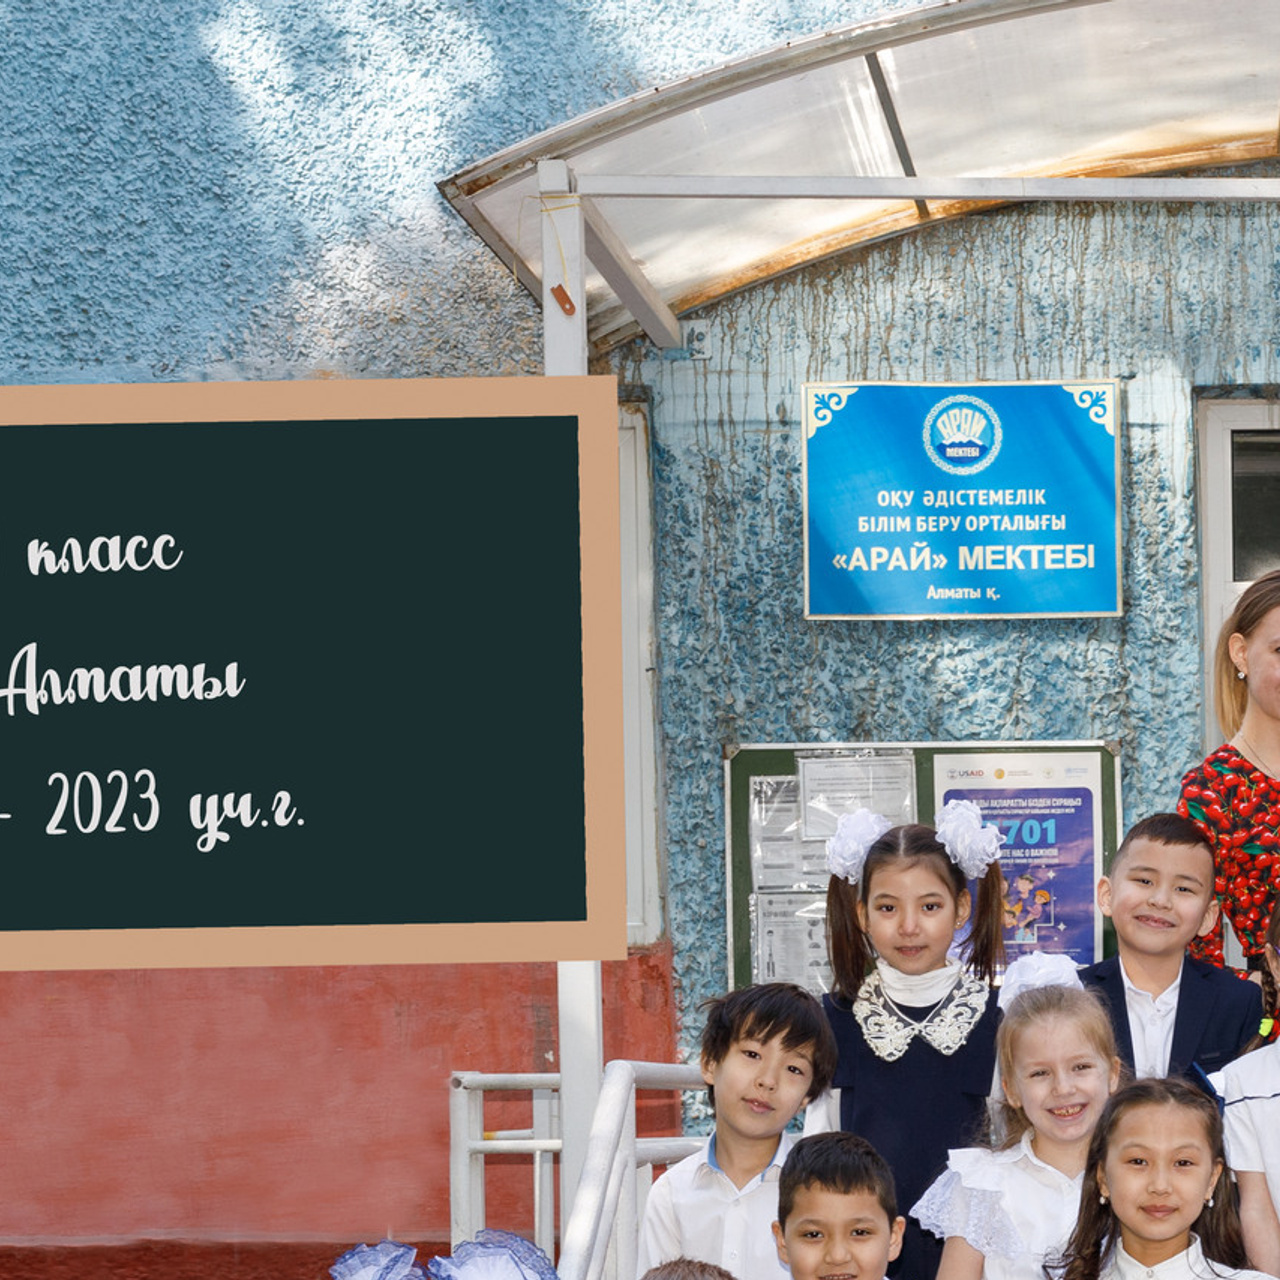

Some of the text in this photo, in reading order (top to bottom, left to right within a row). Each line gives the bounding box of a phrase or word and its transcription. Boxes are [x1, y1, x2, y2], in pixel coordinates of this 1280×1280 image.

[876, 489, 1046, 510] ОҚУ ӘДІСТЕМЕЛІК
[858, 515, 1066, 532] БІЛІМ БЕРУ ОРТАЛЫҒЫ
[27, 533, 184, 576] класс
[832, 541, 1095, 571] «АРАЙ» МЕКТЕБІ
[926, 585, 1001, 602] Алматы қ.
[0, 641, 247, 717] Алматы
[45, 768, 161, 835] 2023
